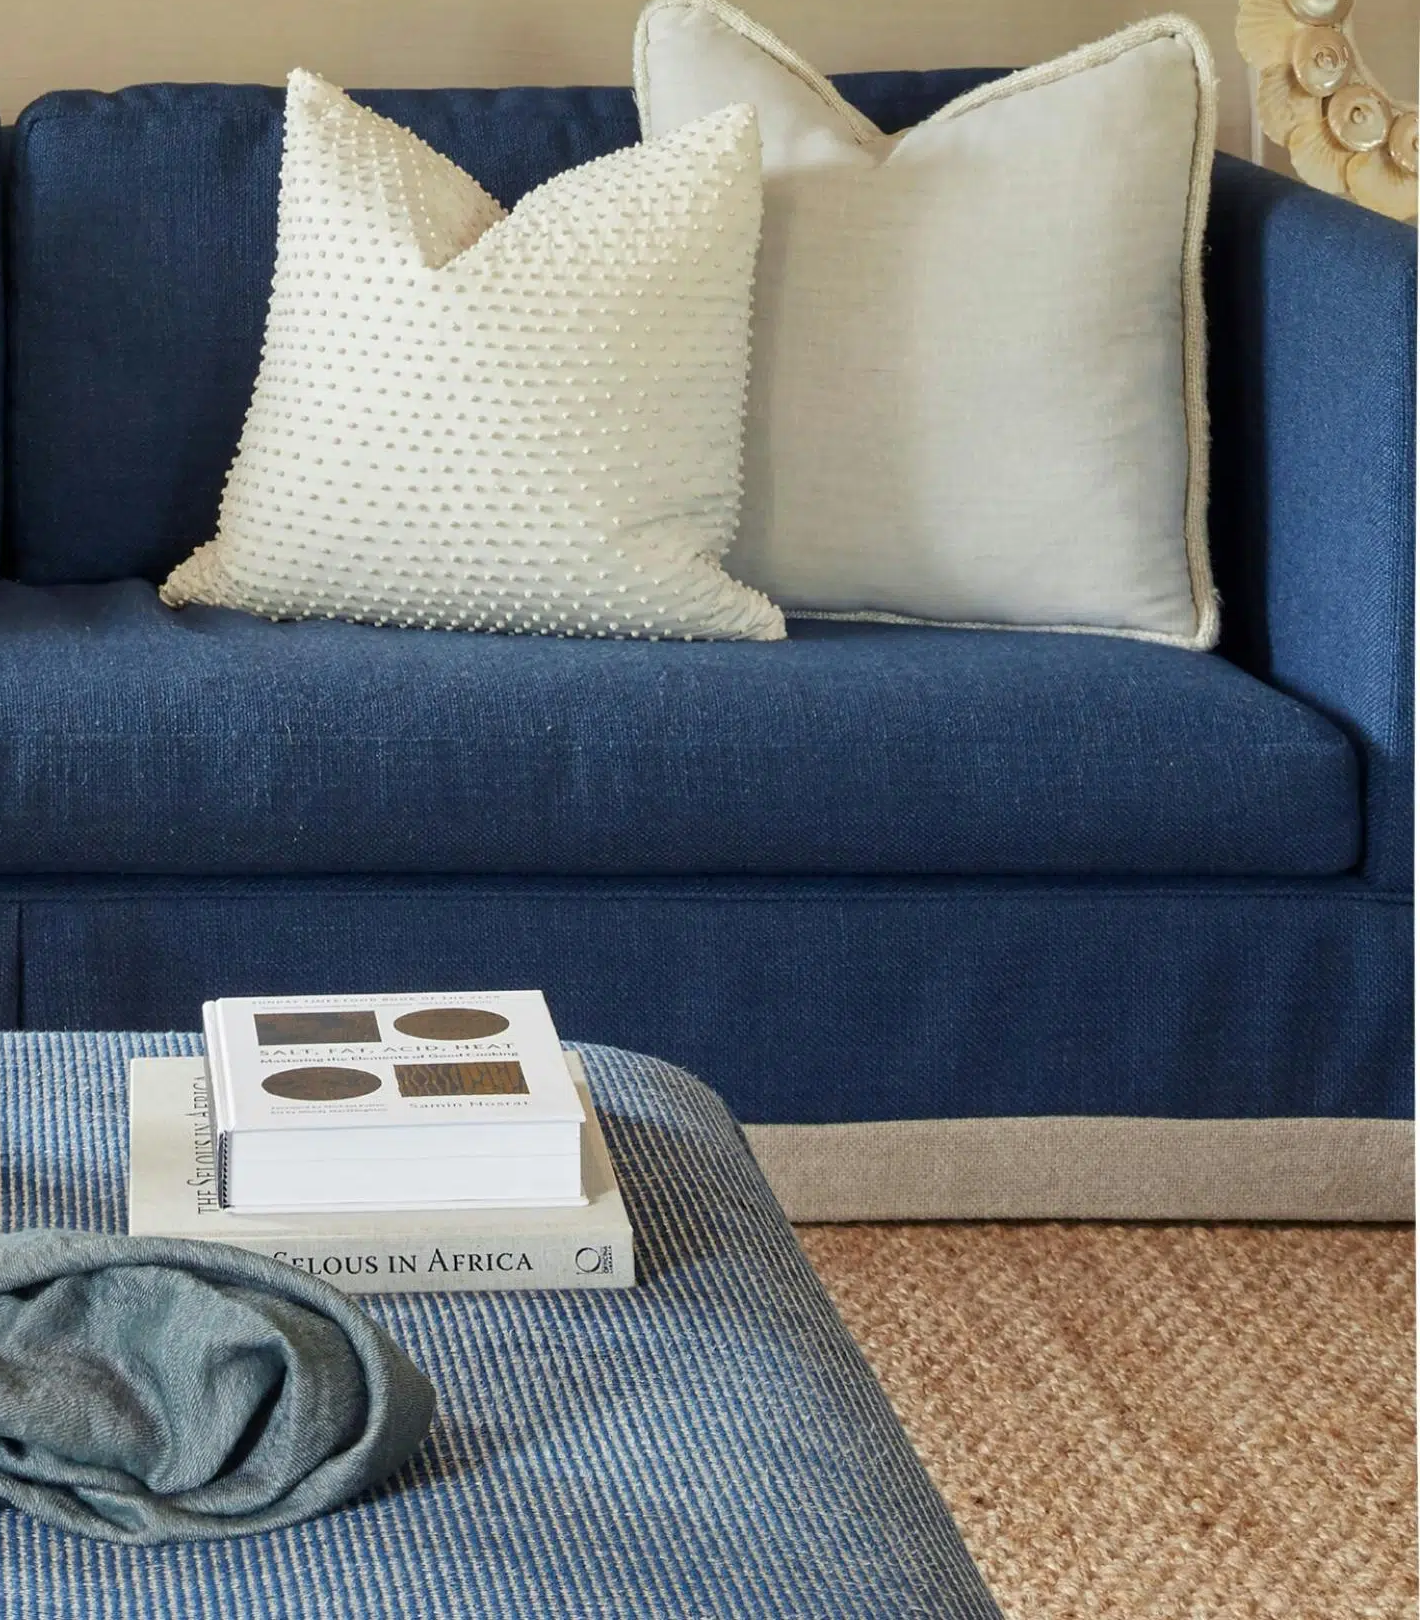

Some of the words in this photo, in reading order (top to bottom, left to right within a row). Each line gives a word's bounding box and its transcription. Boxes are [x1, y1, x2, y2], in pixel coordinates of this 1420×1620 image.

[260, 1049, 319, 1057] SALT,
[194, 1123, 212, 1136] IN
[186, 1139, 216, 1186] SELOUS
[197, 1190, 220, 1215] THE
[388, 1255, 417, 1274] IN
[427, 1248, 534, 1272] AFRICA
